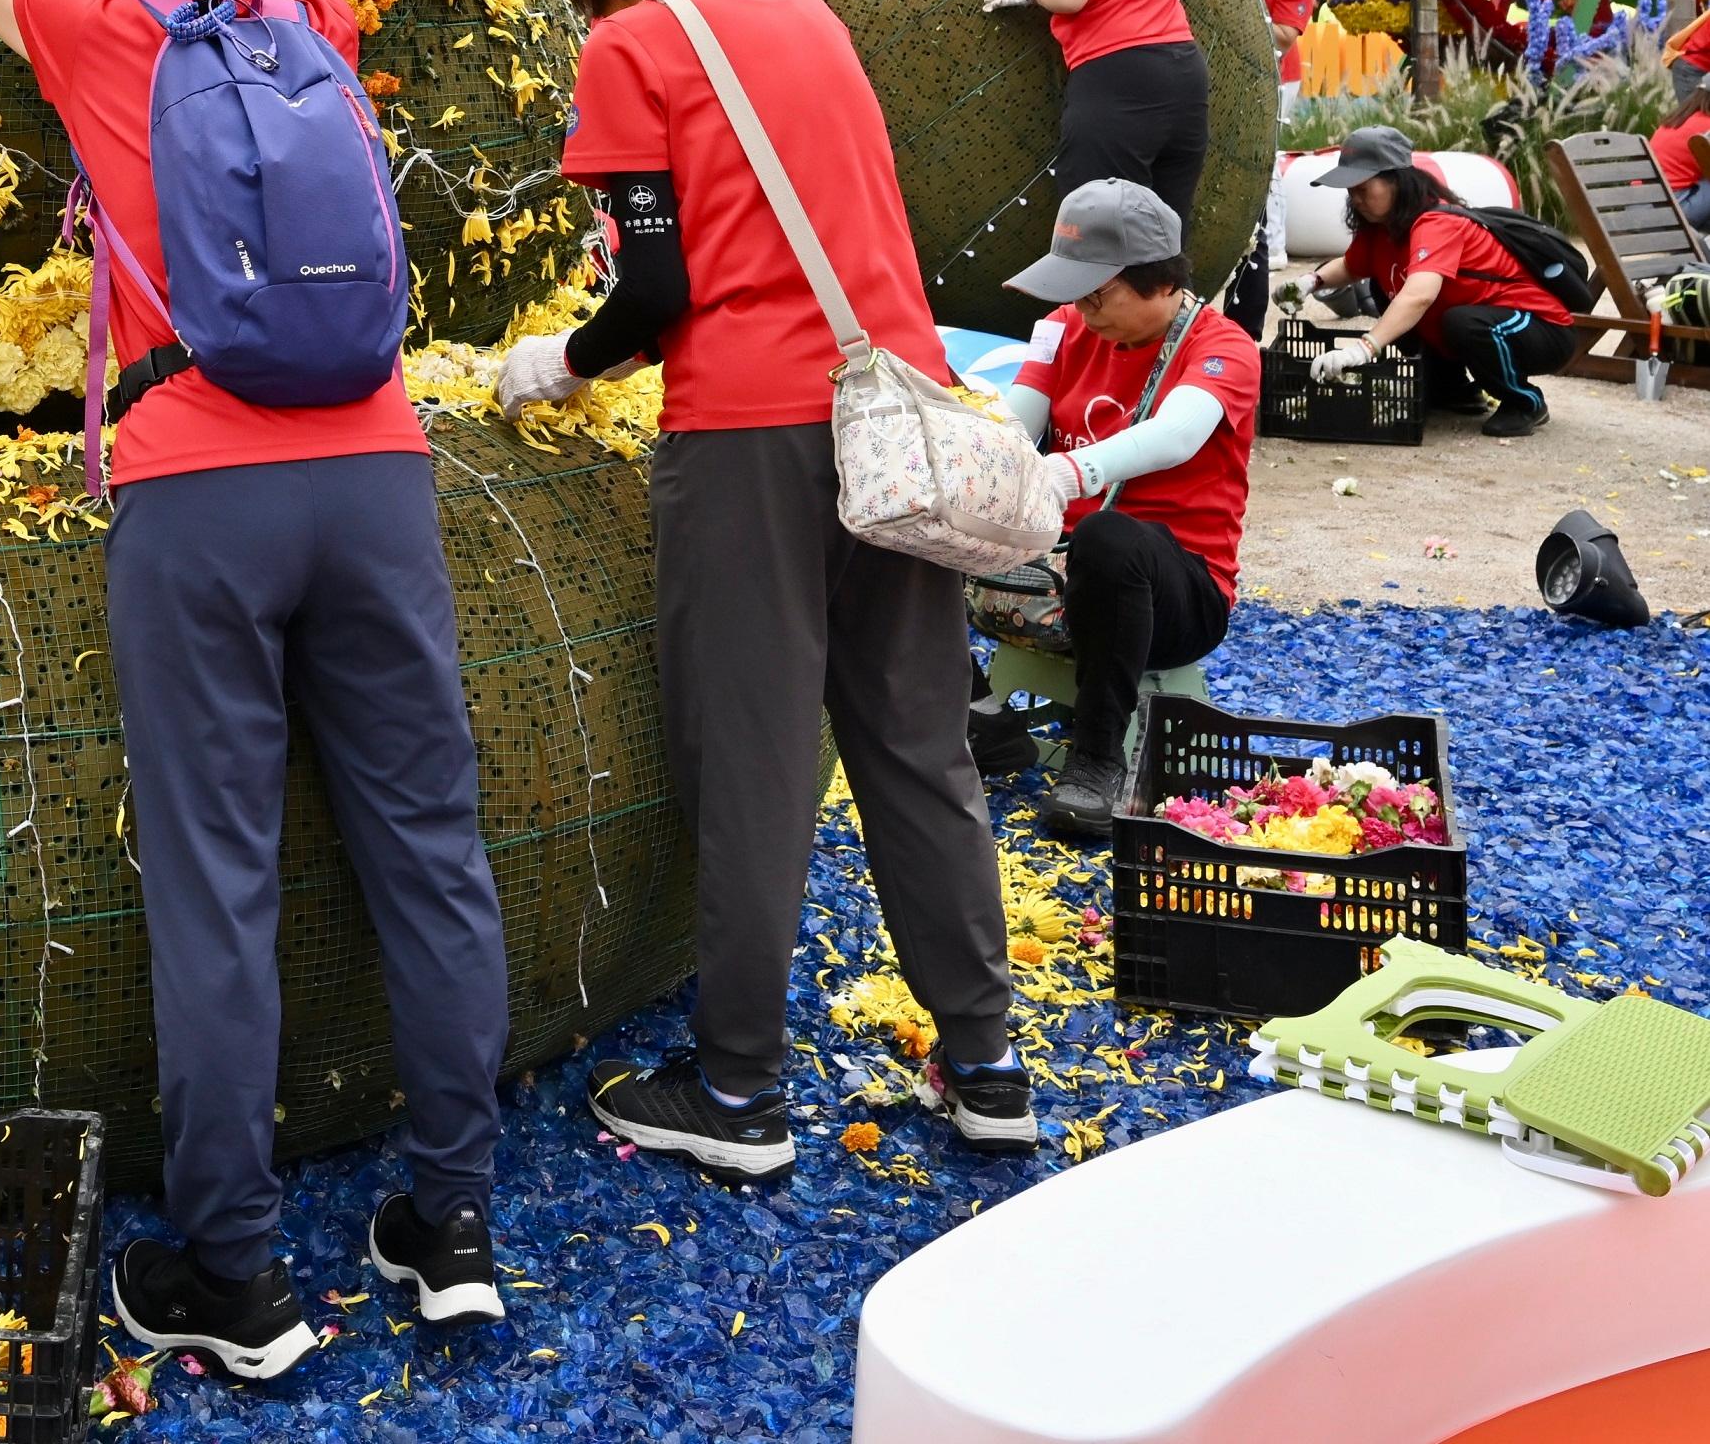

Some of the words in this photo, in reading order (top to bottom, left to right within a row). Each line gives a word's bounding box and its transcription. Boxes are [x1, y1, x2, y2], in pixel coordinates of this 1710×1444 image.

[625, 217, 673, 228] 香港賽馬會
[235, 240, 245, 249] 10
[239, 250, 256, 281] ARPENAZ
[300, 264, 356, 276] Quechua
